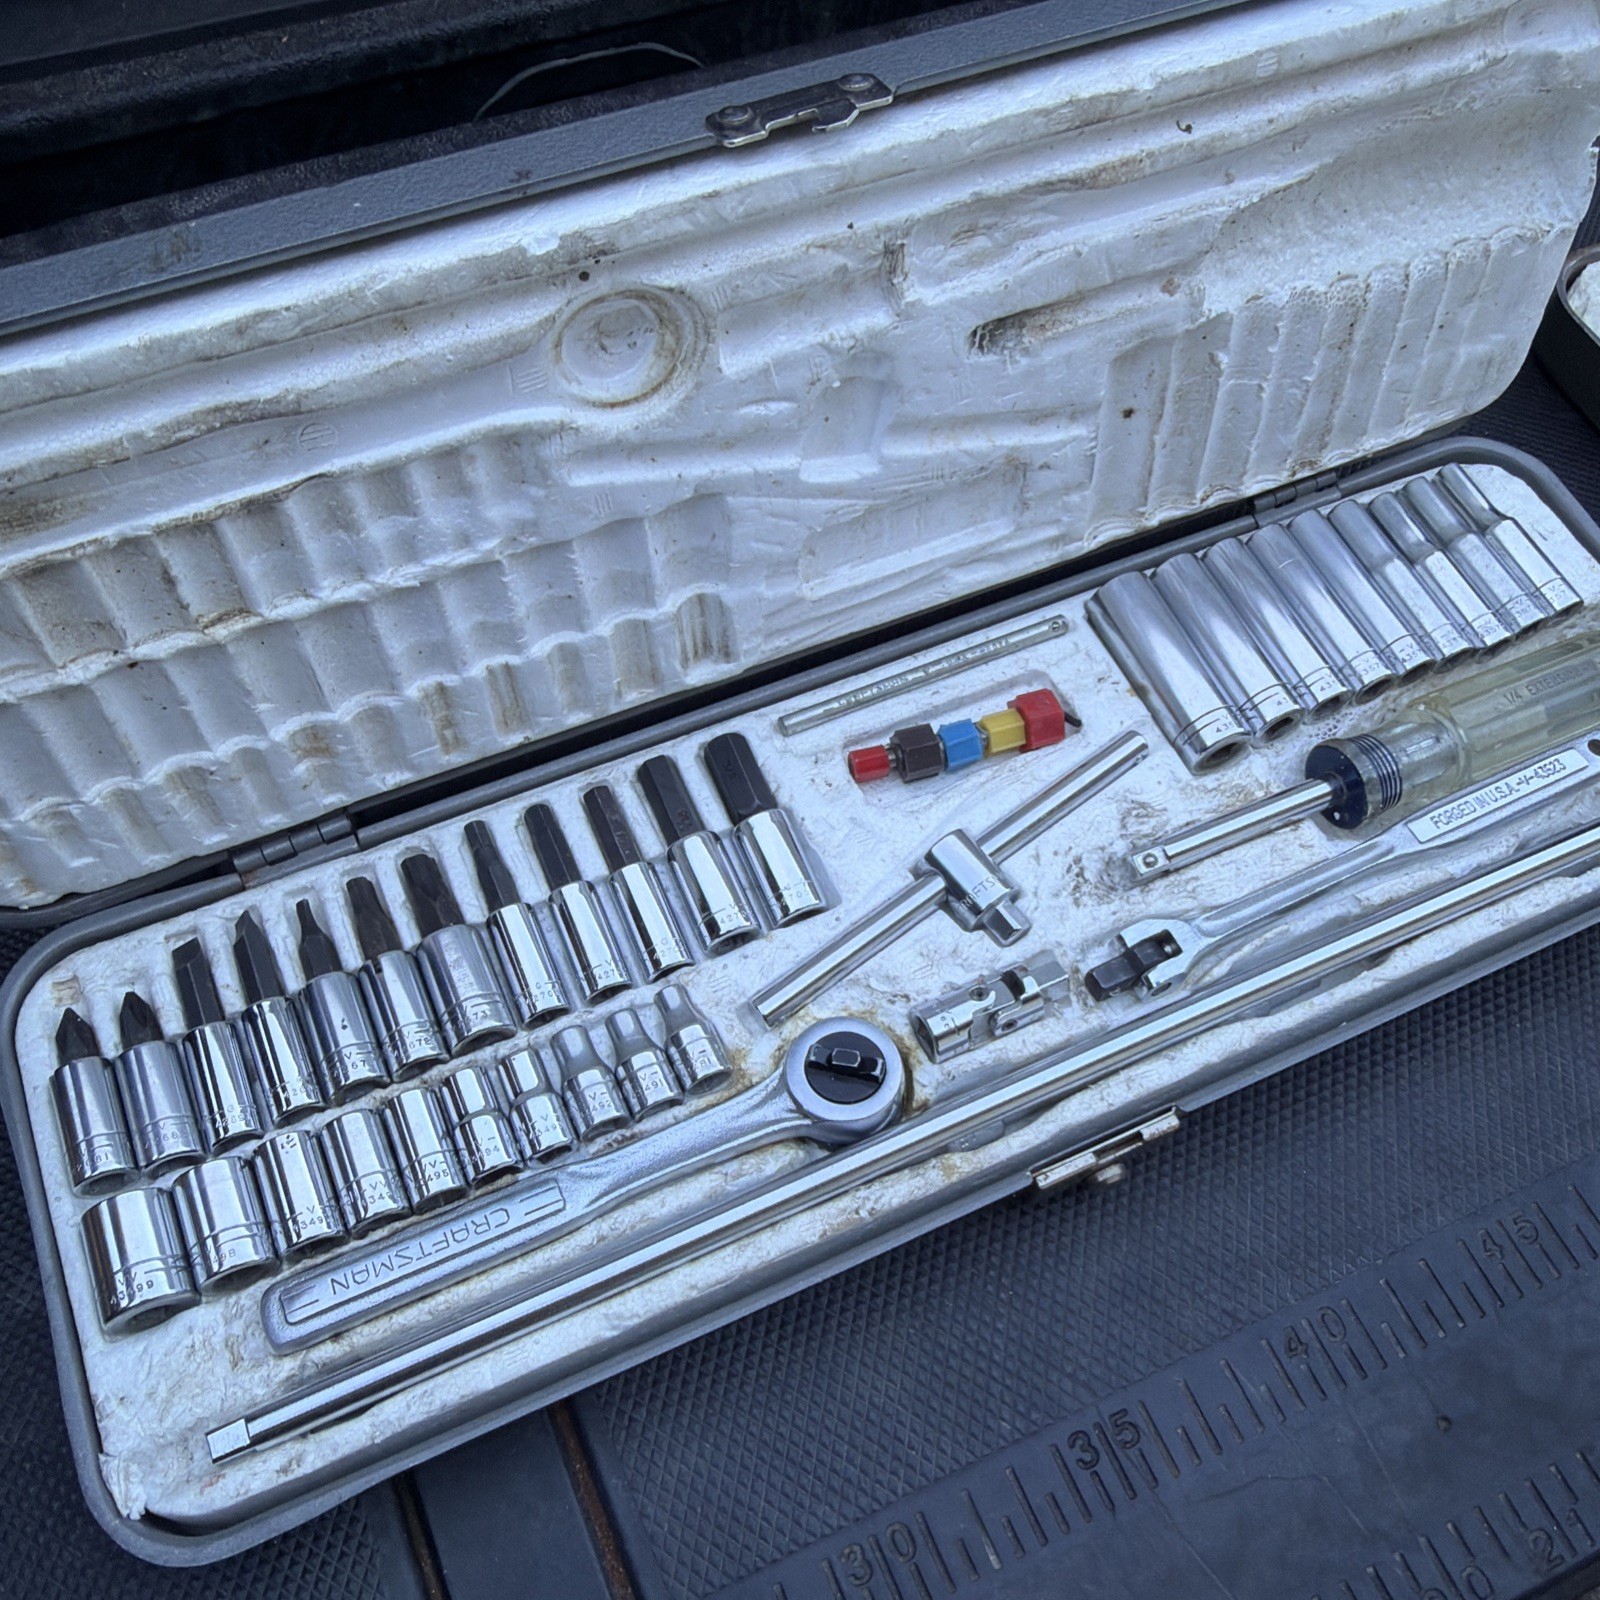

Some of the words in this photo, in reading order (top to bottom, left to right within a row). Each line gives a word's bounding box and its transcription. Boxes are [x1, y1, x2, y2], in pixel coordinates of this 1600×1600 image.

[1429, 800, 1477, 830] FORGED
[329, 1206, 511, 1296] CRAFTSMAN
[1478, 1210, 1539, 1262] 45
[1283, 1305, 1347, 1360] 40
[1067, 1407, 1142, 1472] 35
[840, 1521, 918, 1588] 30
